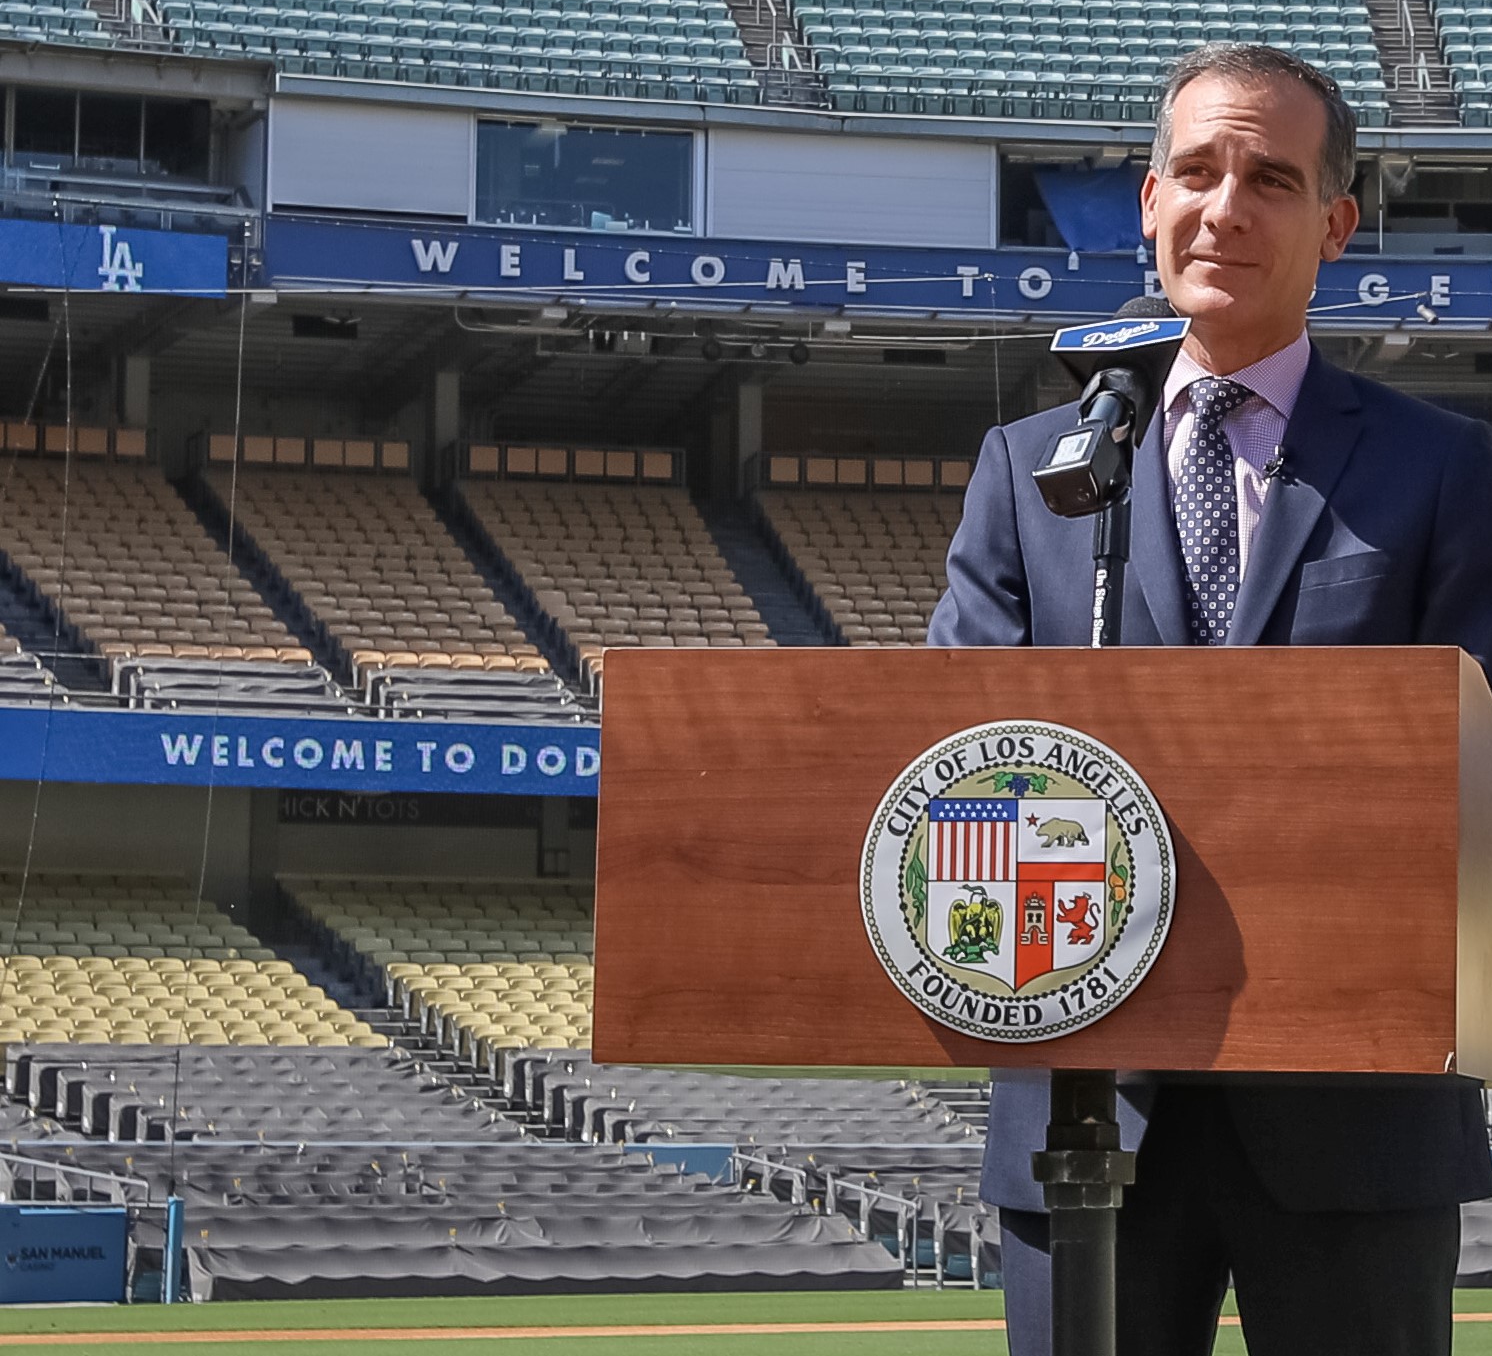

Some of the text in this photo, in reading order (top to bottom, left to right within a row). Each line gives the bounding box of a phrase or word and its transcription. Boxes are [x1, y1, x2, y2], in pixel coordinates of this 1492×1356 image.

[98, 224, 143, 292] LA
[411, 239, 867, 293] WELCOME
[957, 265, 1052, 300] TO
[1082, 321, 1160, 348] Dodgers
[1096, 569, 1107, 587] On
[1093, 588, 1106, 619] Stage
[160, 733, 393, 772] WELCOME
[416, 740, 476, 774] TO
[887, 736, 1149, 837] CITY OF LOS ANGELES
[907, 959, 1121, 1027] FOUNDED 1781
[20, 1246, 107, 1260] SAN MANUEL
